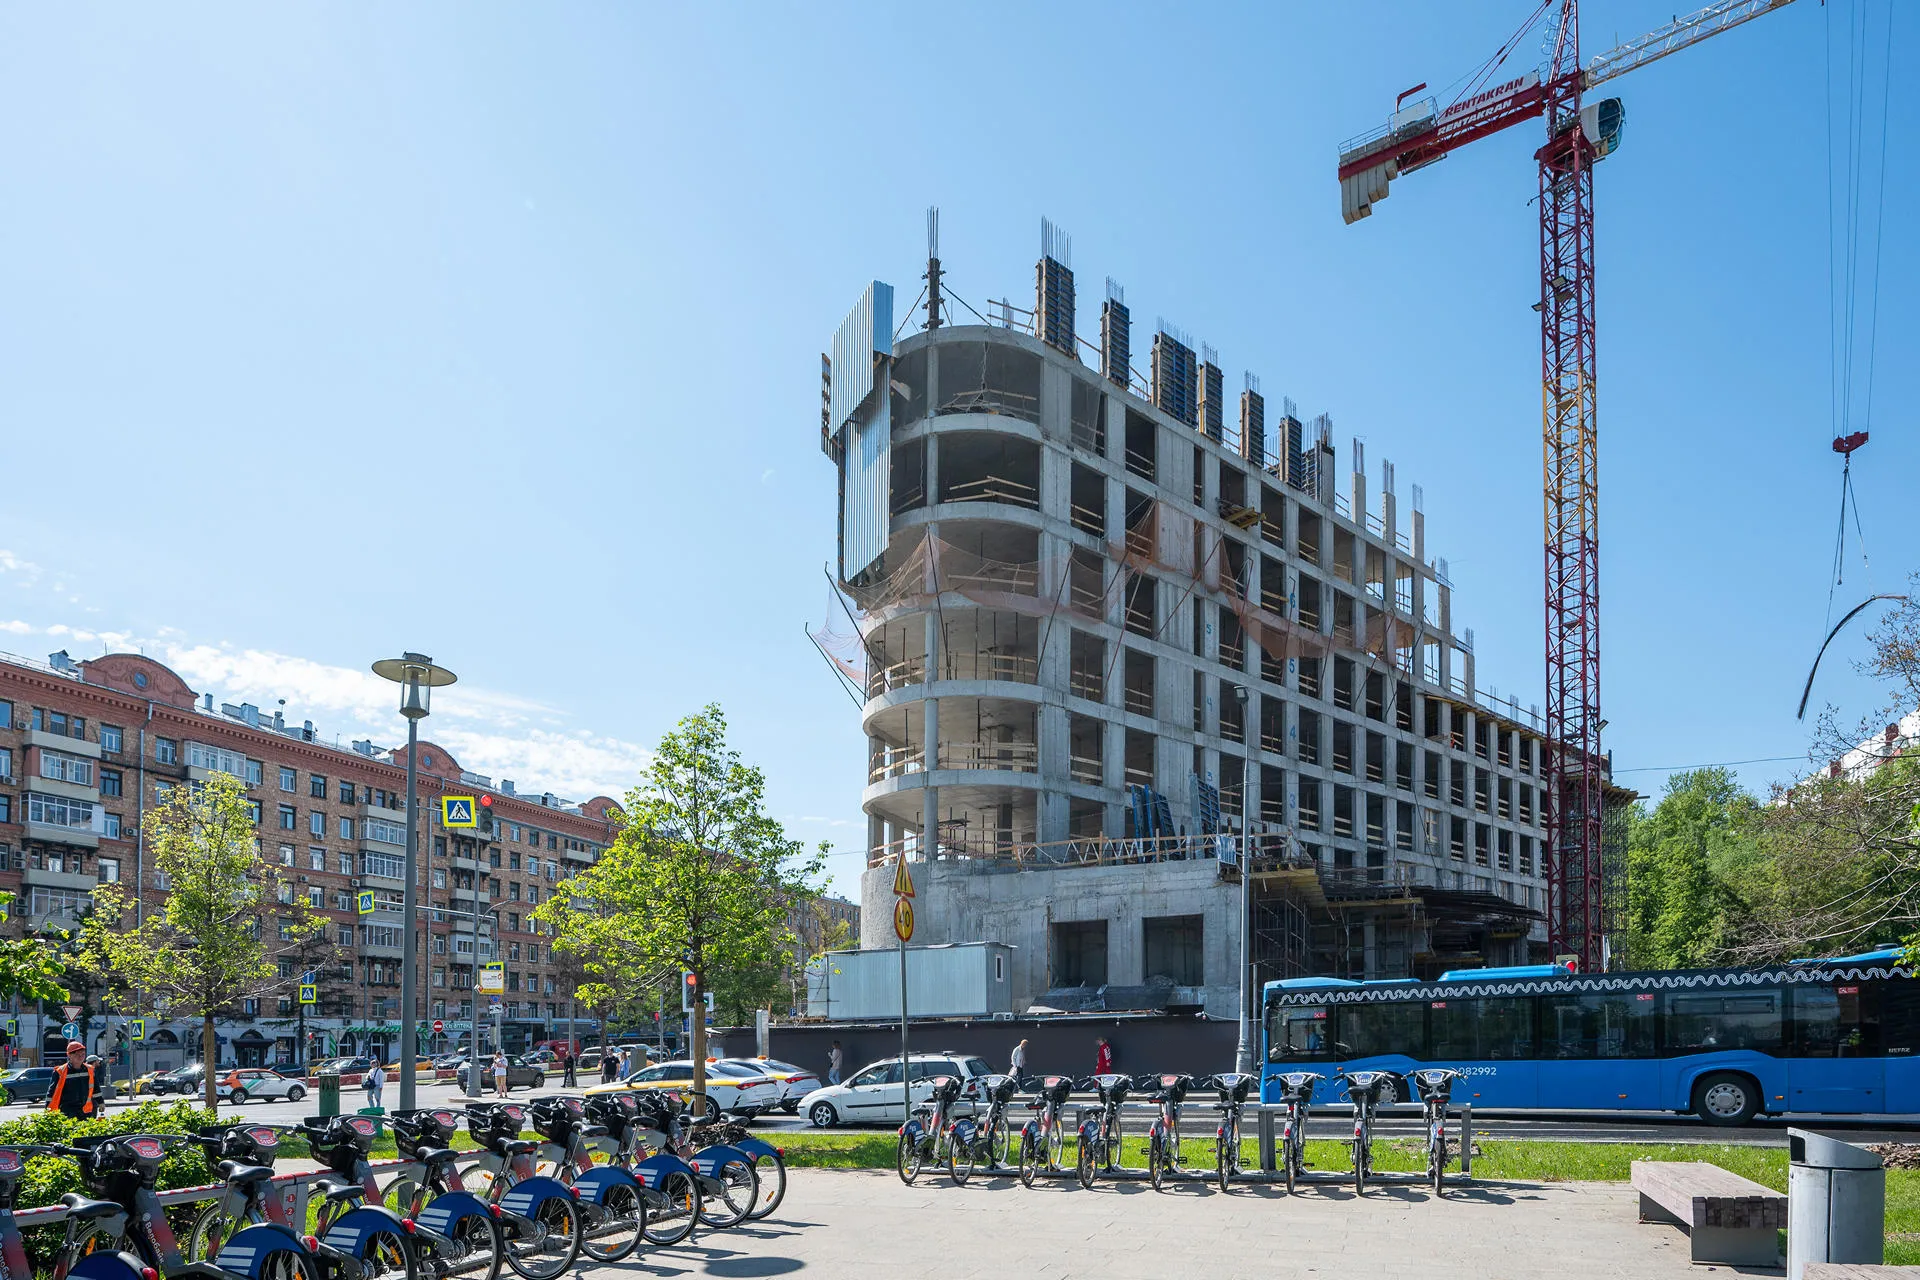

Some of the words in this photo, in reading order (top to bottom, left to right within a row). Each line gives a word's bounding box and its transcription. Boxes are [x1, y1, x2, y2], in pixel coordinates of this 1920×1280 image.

[1444, 76, 1524, 117] RENTAKRAN
[1437, 99, 1512, 136] RENTAKRAN
[1289, 658, 1295, 673] 5
[1289, 725, 1296, 740] 4
[1289, 794, 1296, 808] 3
[898, 910, 910, 928] 40
[1458, 1066, 1497, 1076] 082992
[444, 1174, 454, 1192] Вело
